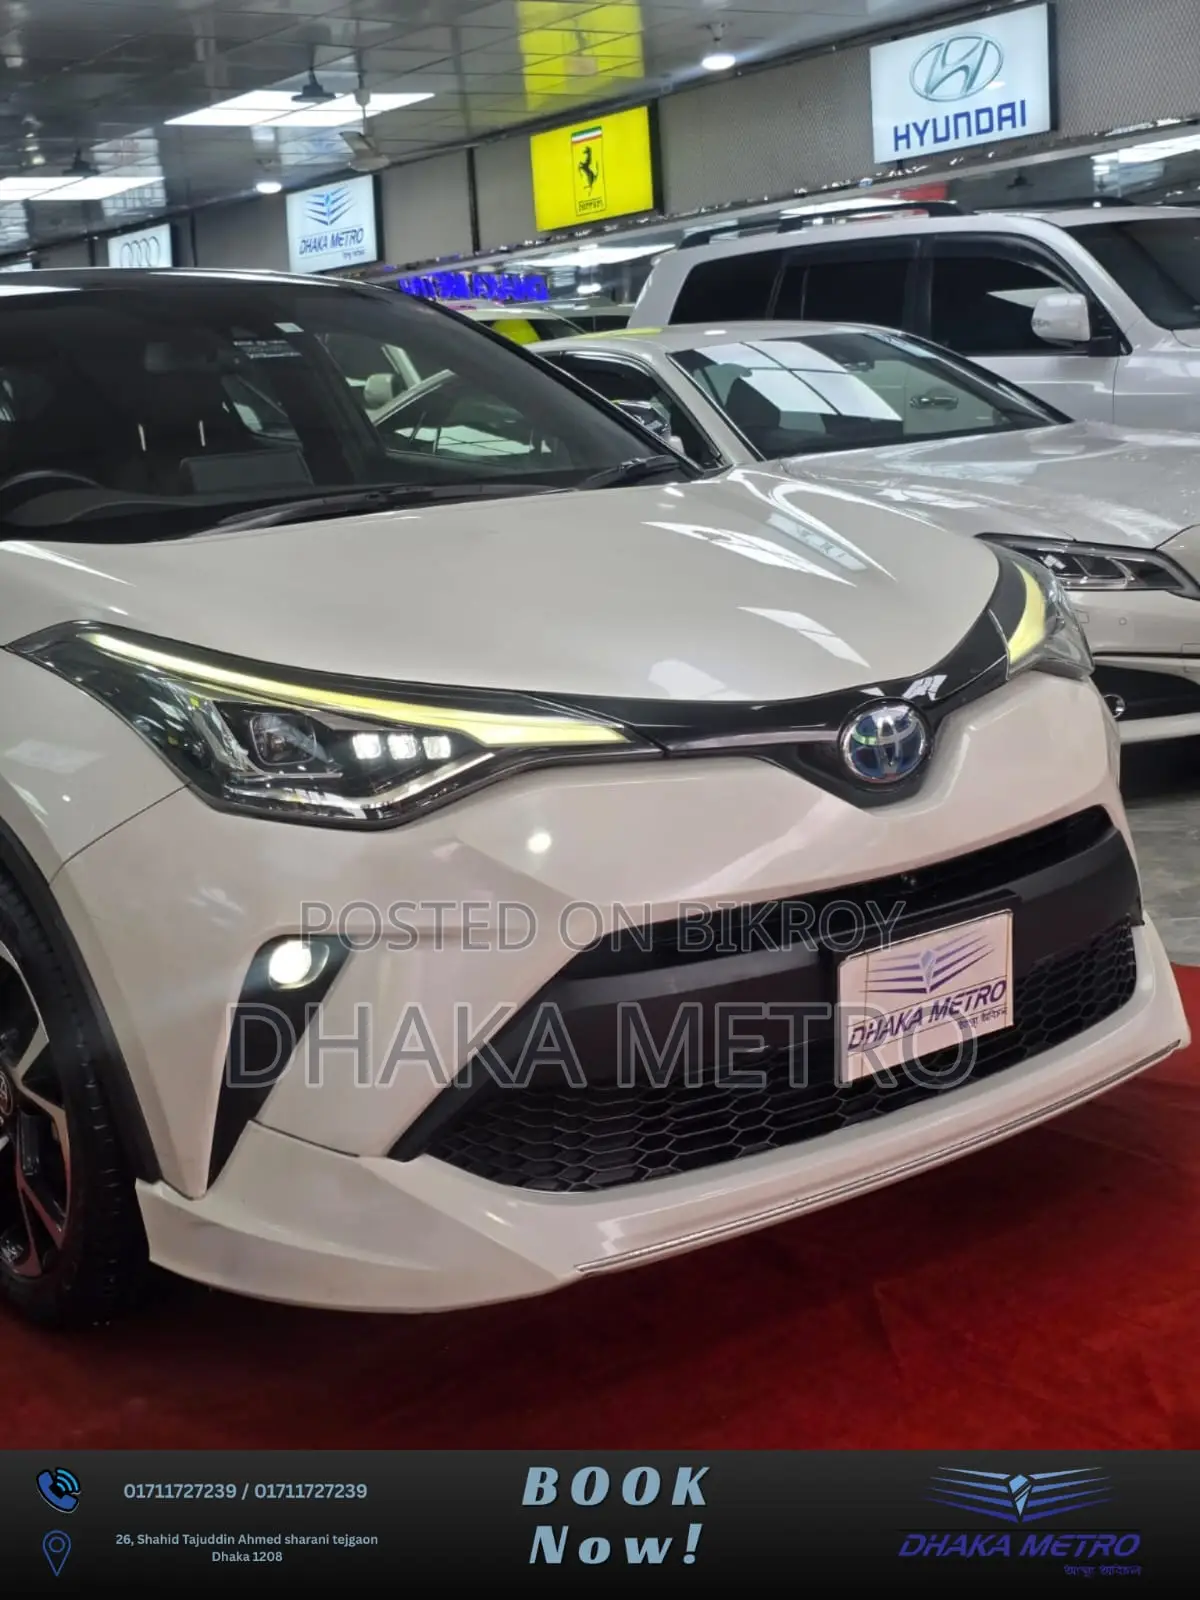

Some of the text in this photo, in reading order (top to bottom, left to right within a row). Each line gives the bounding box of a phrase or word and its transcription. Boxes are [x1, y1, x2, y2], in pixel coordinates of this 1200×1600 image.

[893, 99, 1026, 152] HYUNDAI
[299, 235, 328, 255] DHAKA
[330, 228, 364, 248] METRO
[847, 1006, 923, 1051] DHAKA
[928, 979, 1007, 1023] METRO
